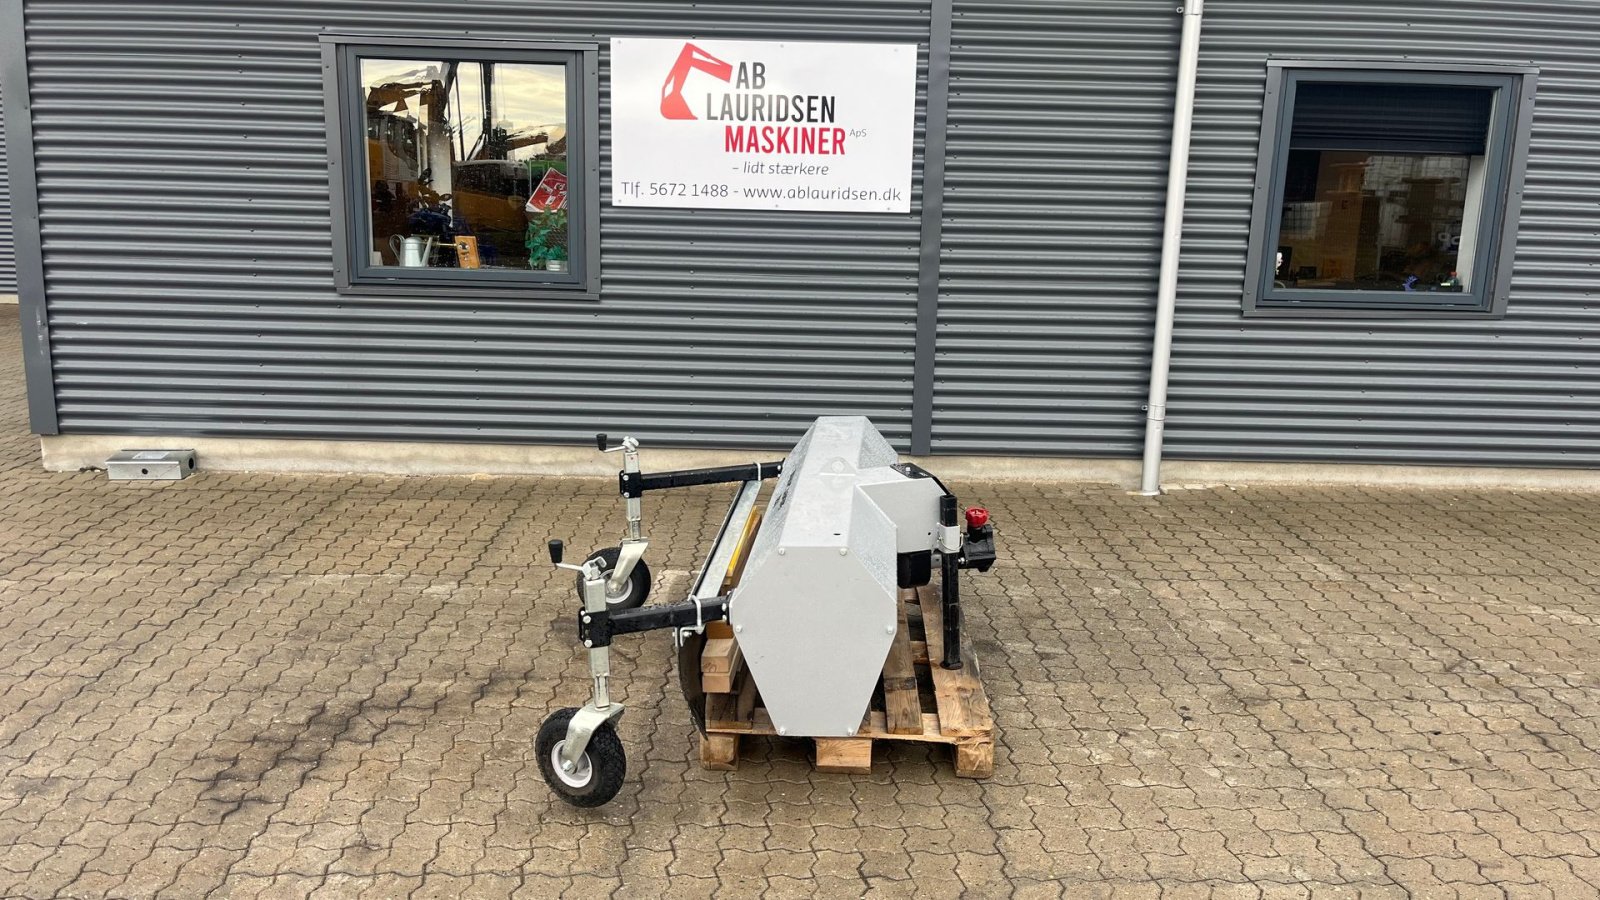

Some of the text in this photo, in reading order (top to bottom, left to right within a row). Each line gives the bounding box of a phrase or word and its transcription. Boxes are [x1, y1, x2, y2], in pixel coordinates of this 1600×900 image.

[736, 62, 766, 90] AB
[706, 92, 835, 123] LAURIDSEN
[725, 125, 867, 155] MASKINER ApS
[743, 161, 765, 174] lidt
[768, 162, 829, 175] stærkere
[621, 181, 645, 198] Tlf.
[649, 182, 686, 197] 5672
[691, 183, 729, 197] 1488
[743, 186, 902, 201] www.ablauridsen.dk
